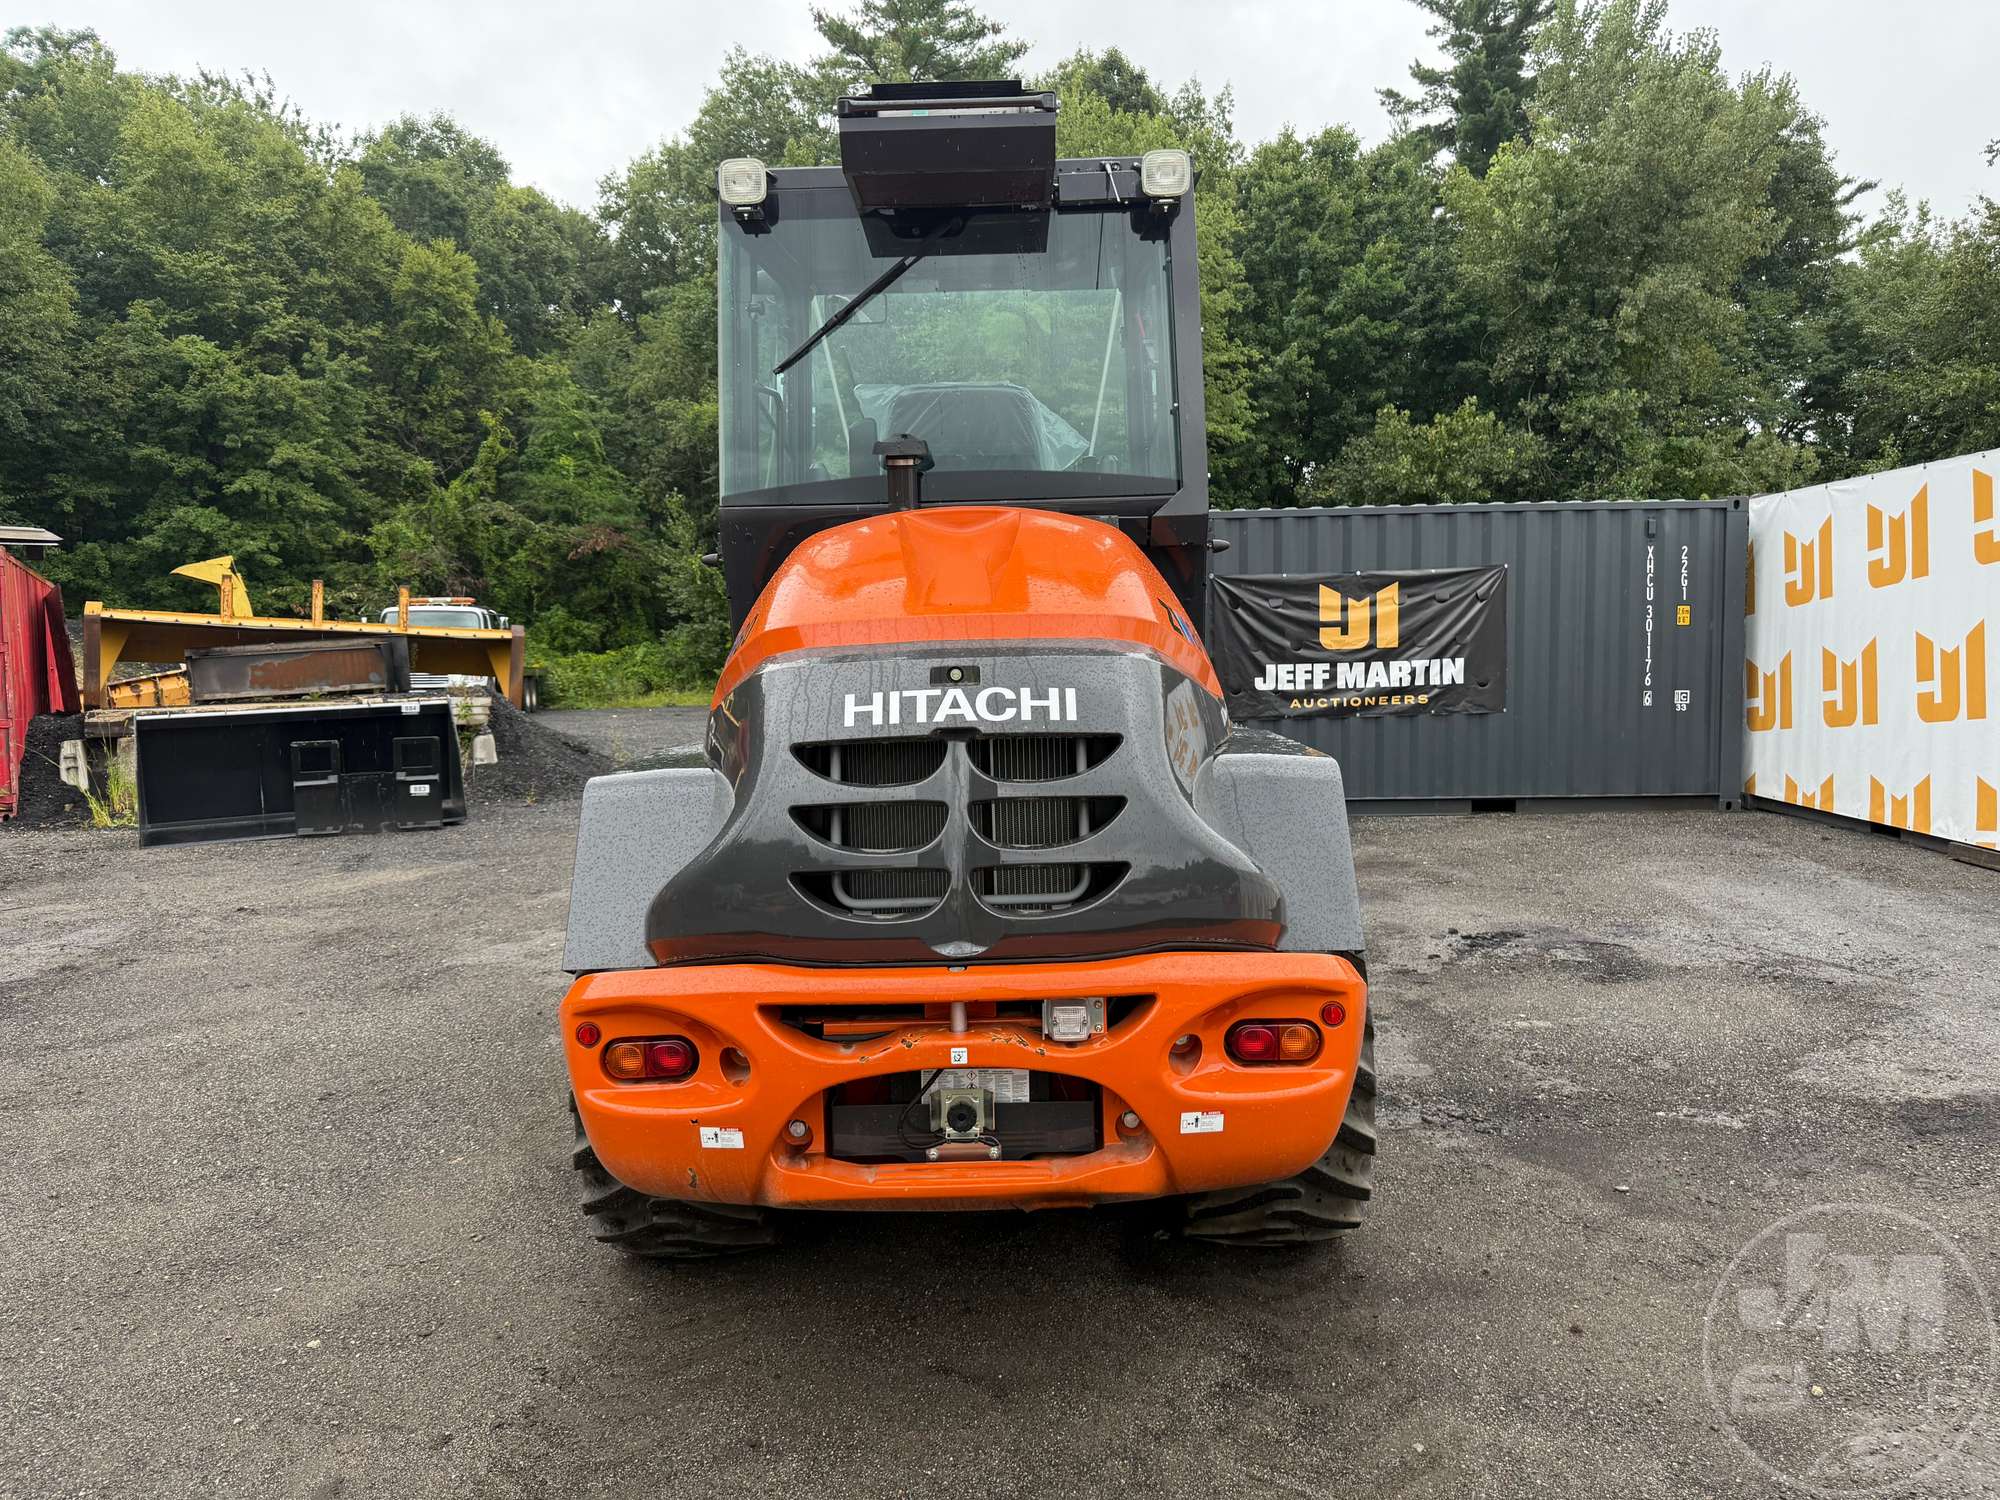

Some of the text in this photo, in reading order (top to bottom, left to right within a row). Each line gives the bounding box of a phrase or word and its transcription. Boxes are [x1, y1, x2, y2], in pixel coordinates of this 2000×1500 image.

[1681, 545, 1689, 601] 22G1
[1643, 545, 1654, 706] XHCU 301176 6
[1254, 657, 1465, 691] JEFF MARTIN
[843, 686, 1078, 728] HITACHI
[1289, 694, 1430, 710] AUCTIONEERS
